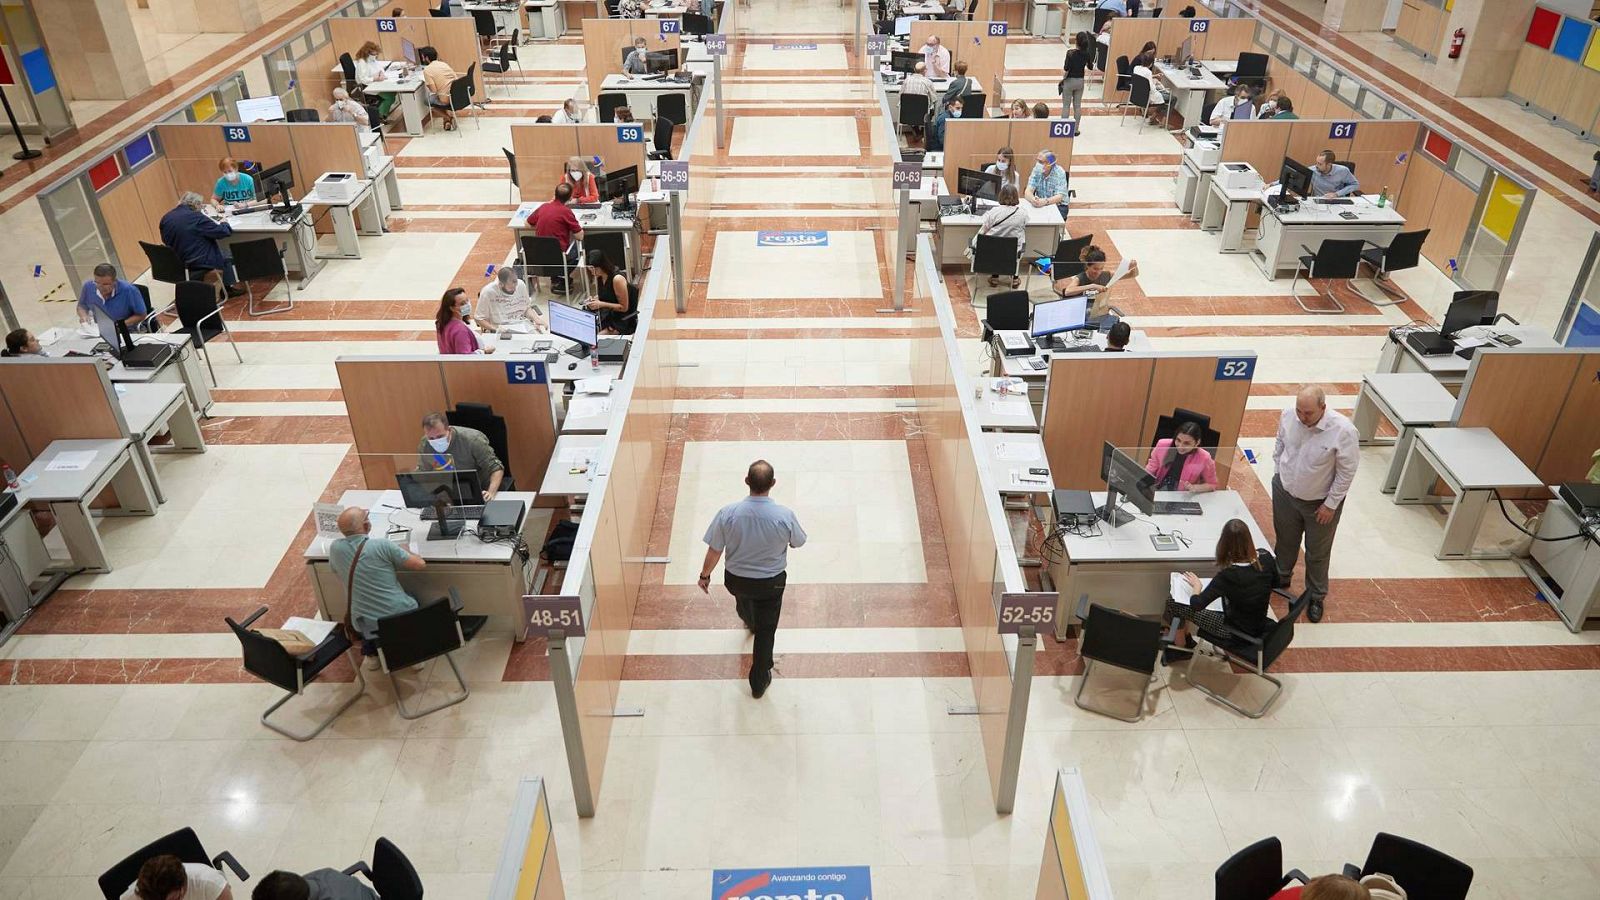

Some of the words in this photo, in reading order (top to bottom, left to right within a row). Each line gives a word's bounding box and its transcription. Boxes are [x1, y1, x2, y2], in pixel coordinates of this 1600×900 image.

[380, 21, 394, 31] 66
[663, 22, 675, 32] 67
[991, 25, 1004, 34] 68
[1193, 22, 1206, 32] 69
[707, 41, 726, 49] 64-67
[868, 41, 886, 50] 68-71
[230, 128, 245, 139] 58
[622, 129, 637, 140] 59
[1054, 124, 1071, 135] 60
[1334, 124, 1351, 136] 61
[662, 171, 687, 182] 56-59
[894, 171, 920, 182] 60-63
[515, 365, 536, 380] 51
[1223, 361, 1247, 376] 52
[531, 610, 580, 626] 48-51
[1002, 607, 1053, 623] 52-55
[771, 874, 815, 882] Avanzando
[817, 873, 846, 882] contigo
